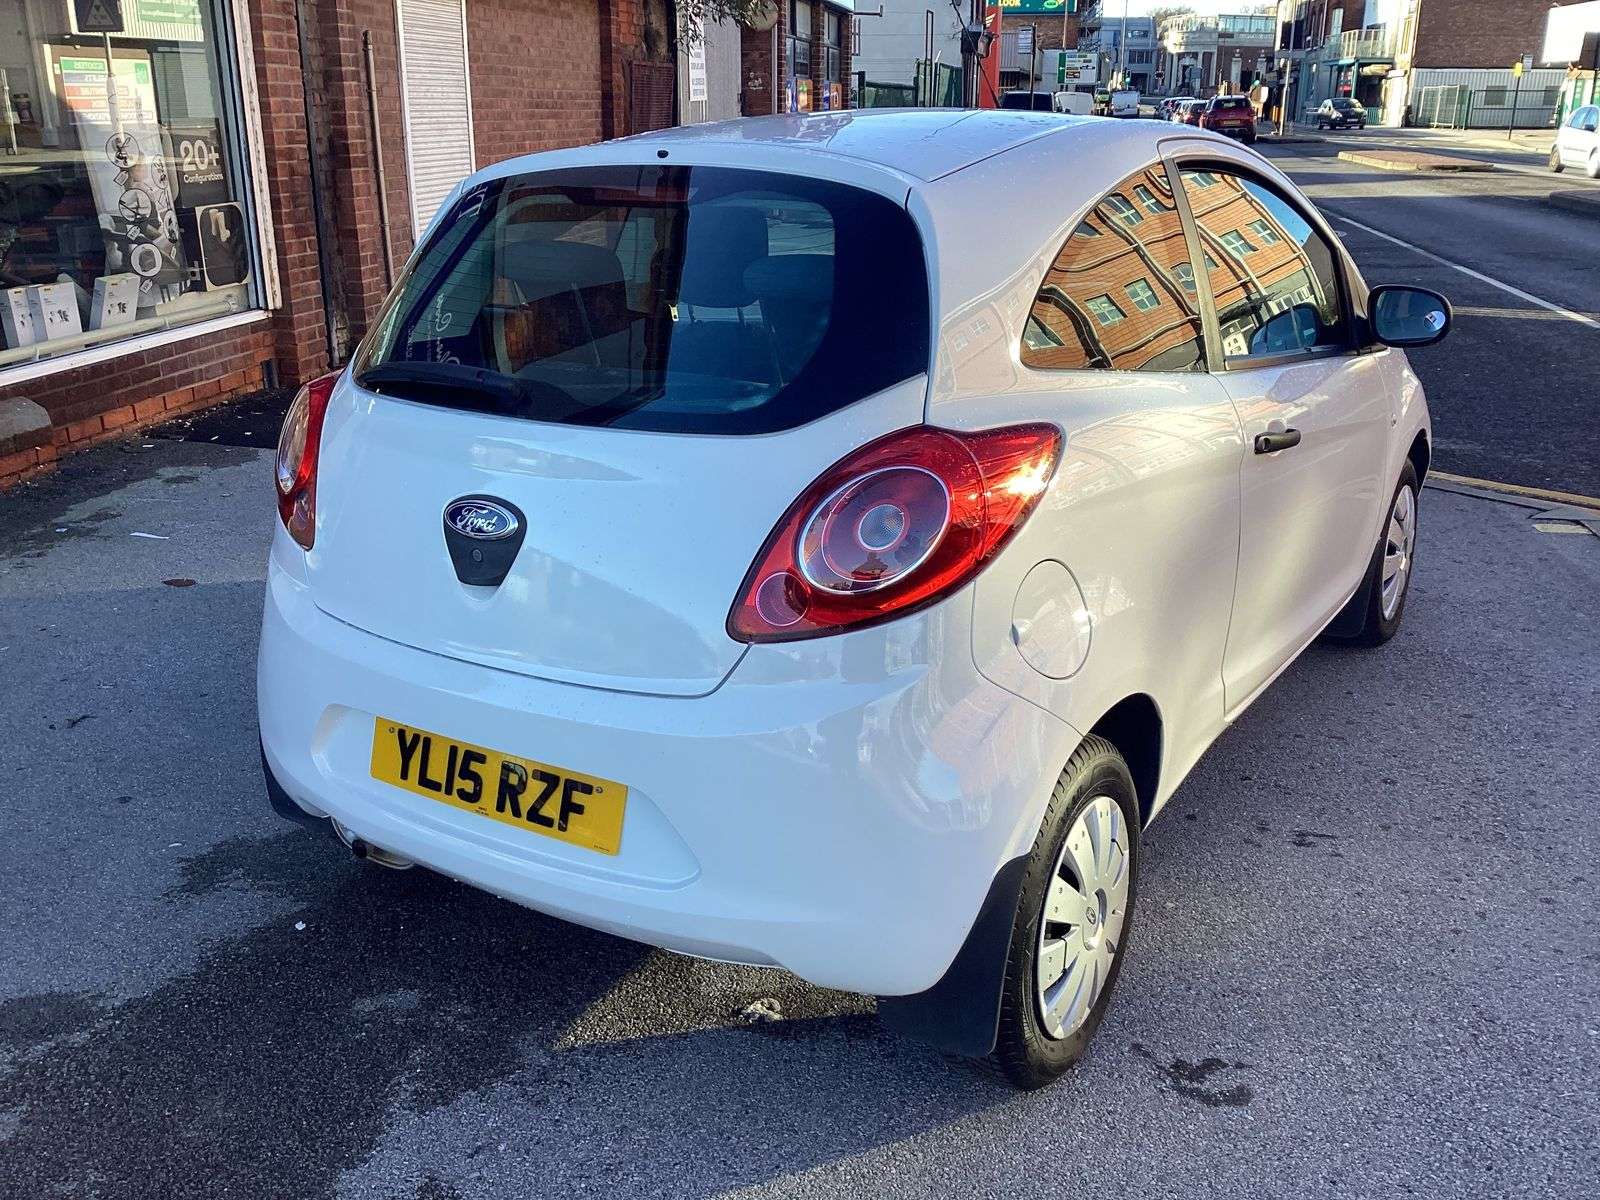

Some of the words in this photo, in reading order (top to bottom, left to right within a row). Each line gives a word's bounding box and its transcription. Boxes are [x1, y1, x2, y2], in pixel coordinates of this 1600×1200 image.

[180, 139, 220, 171] 20+
[183, 172, 224, 184] Configurations
[456, 506, 499, 532] Ford
[397, 728, 487, 804] YL15
[495, 760, 594, 832] RZF
